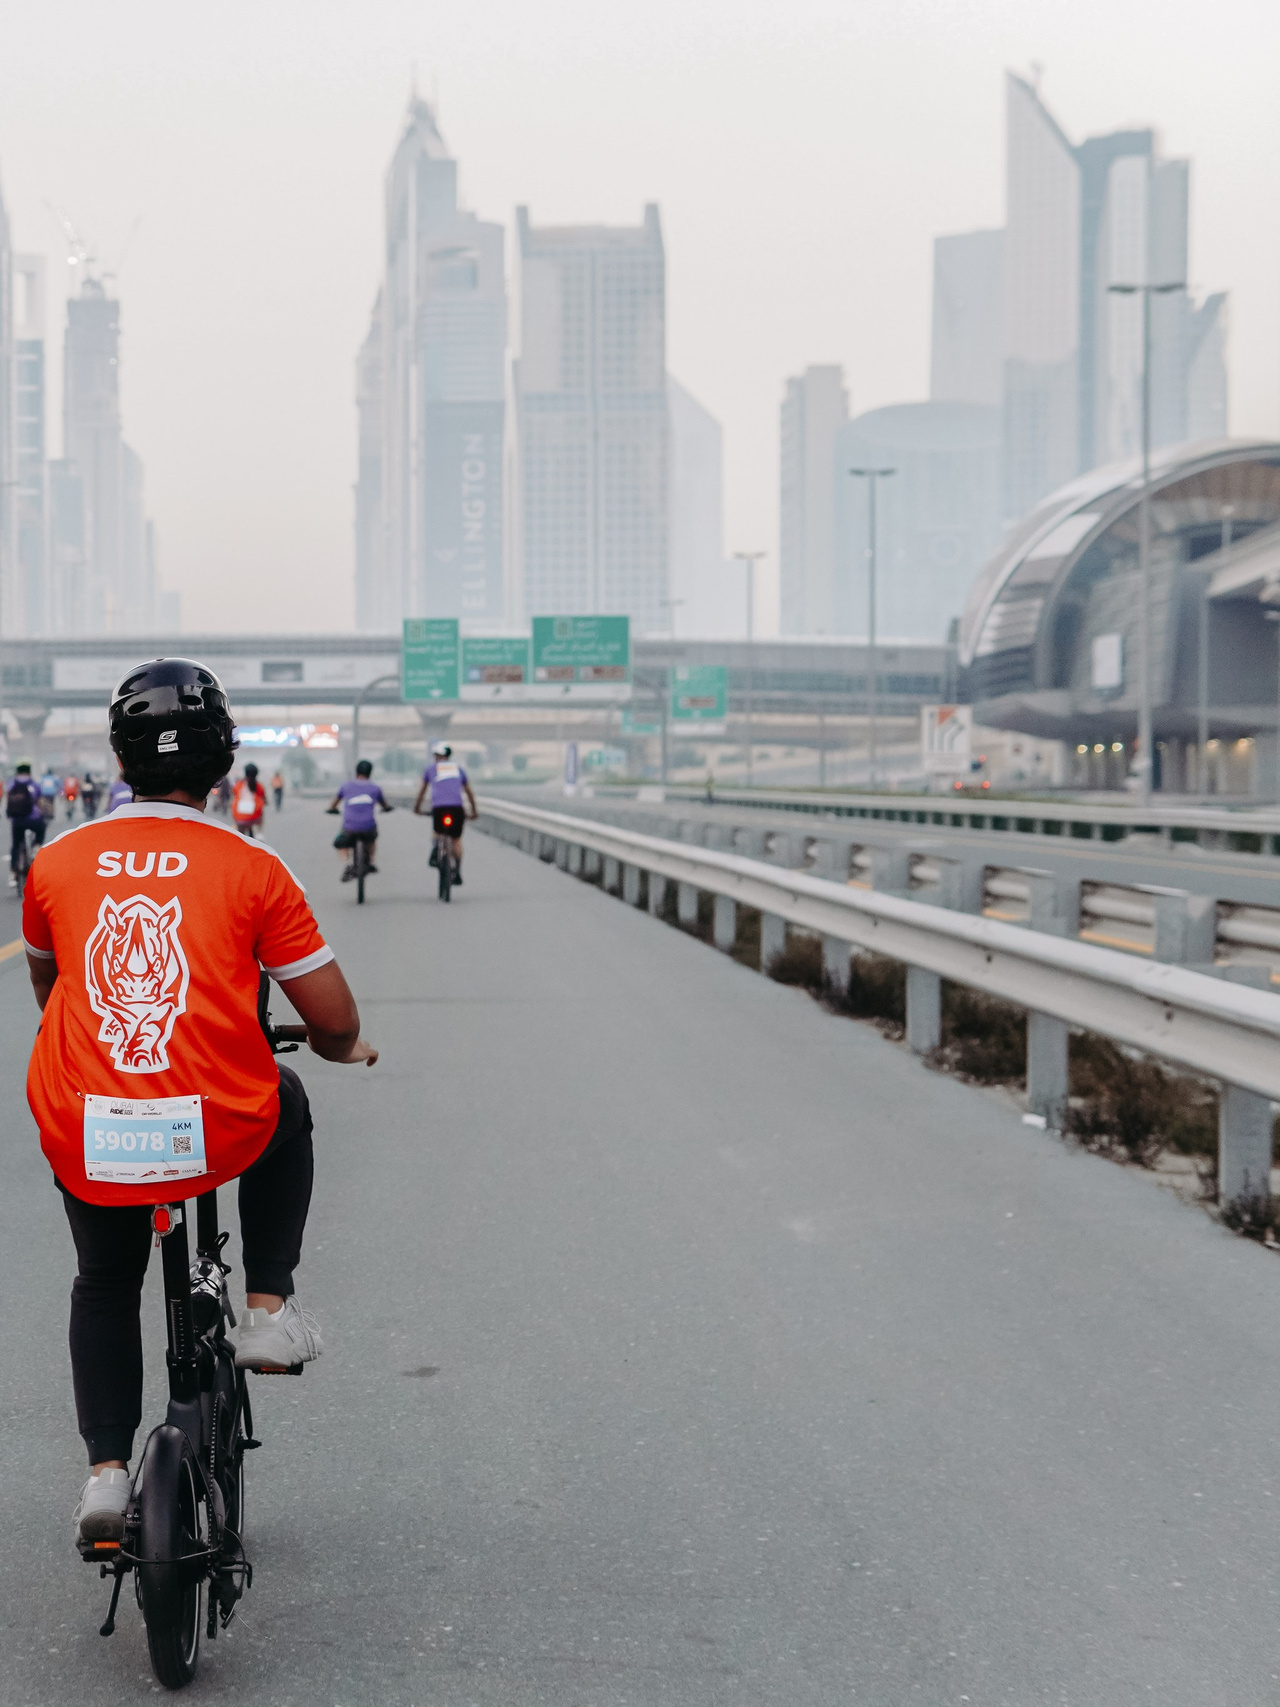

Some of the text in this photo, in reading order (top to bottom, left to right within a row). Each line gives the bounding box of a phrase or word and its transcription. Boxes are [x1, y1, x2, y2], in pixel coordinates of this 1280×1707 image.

[462, 433, 486, 609] ELLINGTON
[95, 850, 189, 878] SUD
[110, 1100, 134, 1109] DUBAI
[172, 1122, 192, 1130] 4KM
[94, 1129, 165, 1151] 59078
